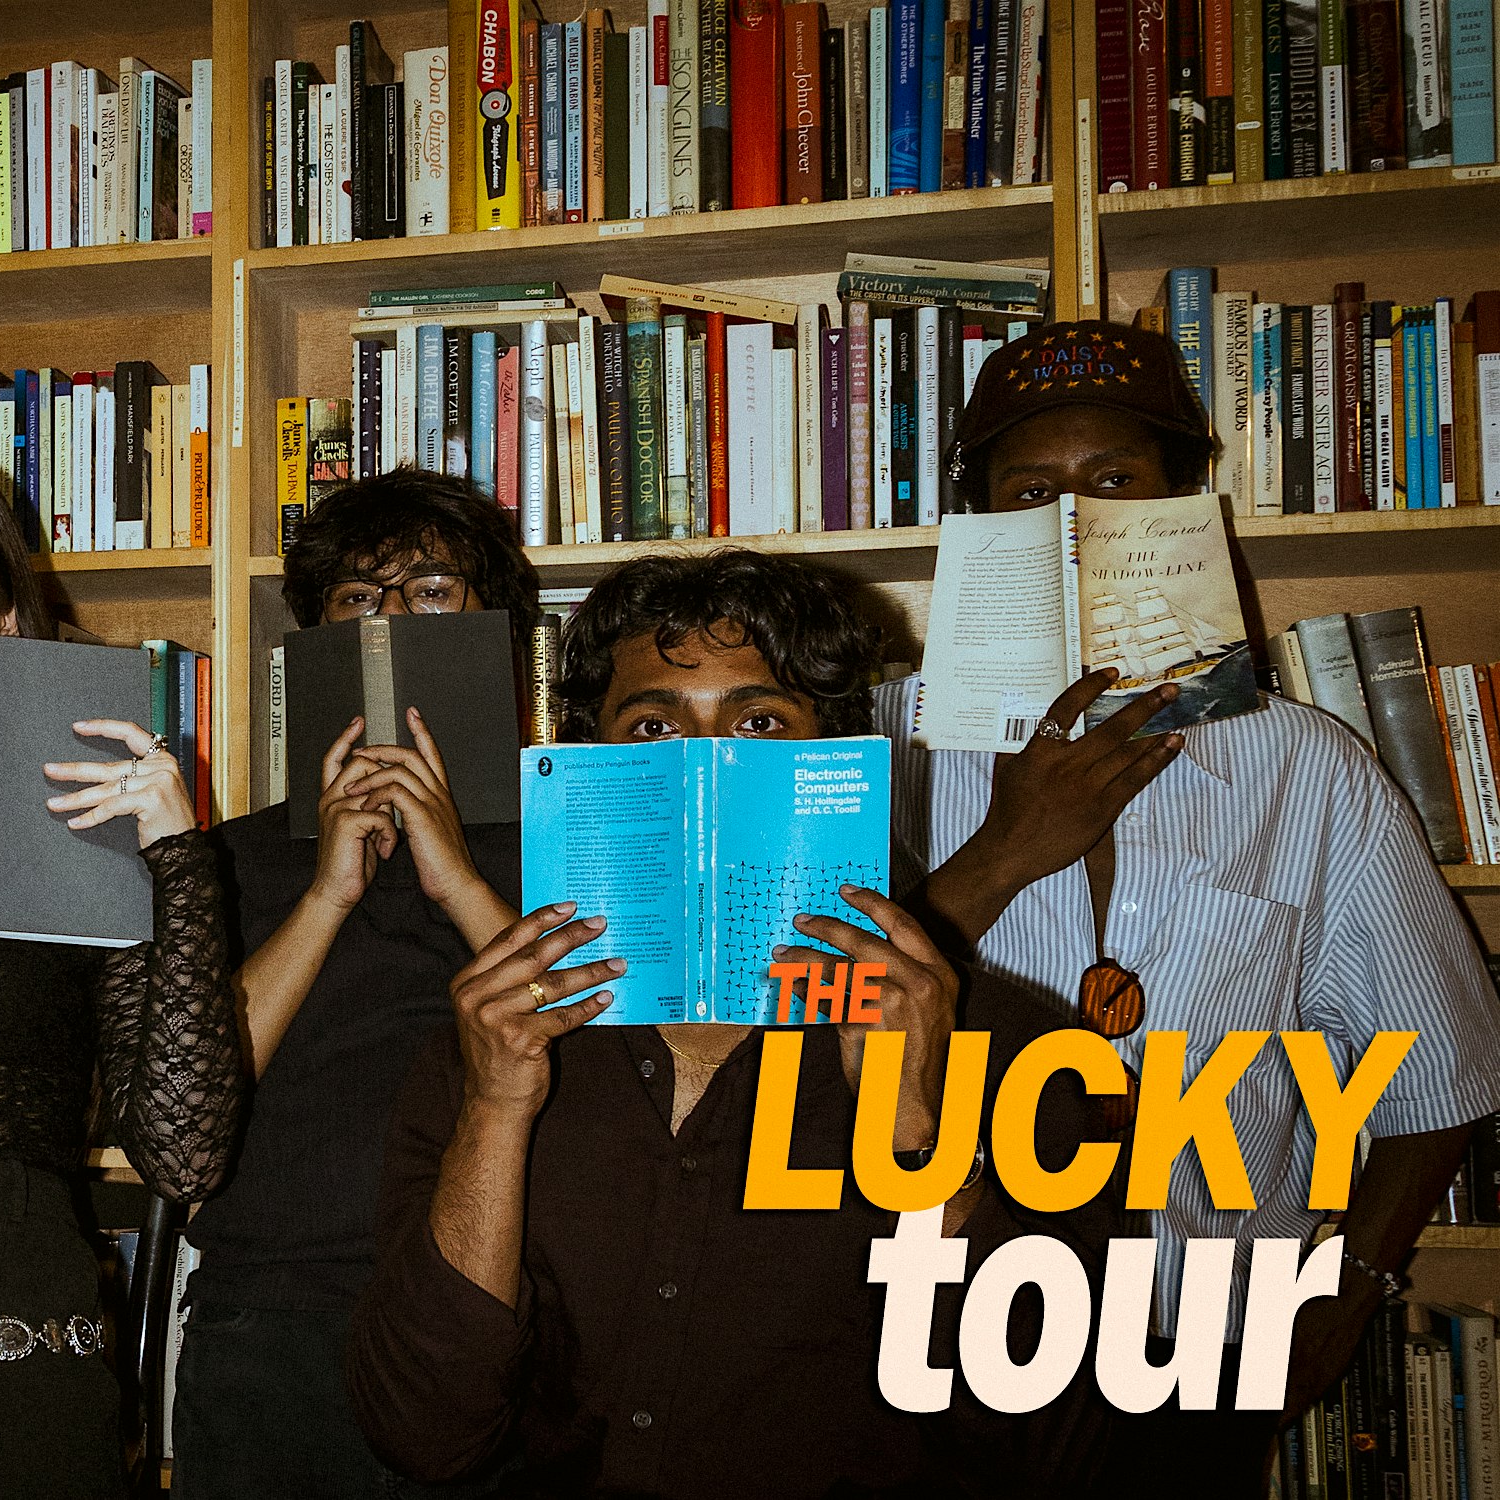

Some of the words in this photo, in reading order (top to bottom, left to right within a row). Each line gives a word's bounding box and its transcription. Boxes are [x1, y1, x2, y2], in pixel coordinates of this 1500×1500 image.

[702, 15, 711, 37] THE
[1456, 10, 1484, 19] EVERY
[481, 9, 498, 84] CHABON
[973, 43, 986, 64] The
[1421, 23, 1433, 67] CIRCUS
[1456, 46, 1486, 55] ALONE
[1460, 35, 1481, 43] DIES
[702, 39, 711, 75] BLACK
[280, 68, 288, 105] ANGELA
[429, 55, 447, 104] Don
[714, 38, 726, 107] CHATWIN
[971, 65, 985, 95] Prime
[1289, 35, 1317, 133] MIDDLESEX
[1459, 80, 1484, 88] HANS
[702, 77, 711, 107] HILL
[792, 71, 812, 109] John
[1146, 66, 1157, 110] LOUISE
[1453, 92, 1492, 100] FALLADA
[414, 99, 423, 127] Miguel
[672, 60, 692, 177] SONGLINES
[970, 96, 984, 140] Minister
[1179, 90, 1194, 131] LOUISE
[415, 129, 422, 137] de
[424, 110, 445, 179] Quixote
[797, 110, 814, 174] Cheever
[1147, 114, 1158, 170] ERDRICH
[414, 138, 422, 181] Cervantes
[1179, 134, 1195, 181] ERDRICH
[1468, 169, 1491, 177] LIT
[525, 288, 546, 296] CORGI
[849, 276, 906, 293] Victory
[913, 286, 948, 297] Joseph
[953, 288, 991, 299] Conrad
[1235, 299, 1247, 349] FAMOUS
[524, 340, 545, 387] Aleph
[1040, 346, 1107, 365] DAISY
[1235, 351, 1248, 383] LAST
[1315, 349, 1329, 397] FISHER
[634, 357, 652, 427] SPANISH
[1235, 386, 1247, 432] WORDS
[1380, 415, 1389, 429] THE
[1315, 404, 1331, 450] SISTER
[1381, 431, 1389, 458] GREAT
[636, 429, 655, 505] DOCTOR
[1316, 454, 1331, 486] AGE
[1382, 459, 1390, 488] GATSBY
[1079, 518, 1128, 546] Joseph
[1137, 517, 1212, 540] Conrad
[1091, 560, 1208, 581] SHADOW-LINE
[1126, 551, 1159, 563] THE
[1369, 668, 1426, 682] Hornblower
[1377, 658, 1415, 672] Admiral
[271, 663, 282, 708] LORD
[271, 713, 282, 739] JIM
[606, 760, 630, 768] Penguin
[794, 753, 800, 761] a
[801, 752, 830, 761] Pelican
[832, 751, 863, 761] Original
[794, 767, 863, 781] Electronic
[794, 780, 869, 795] Computers
[794, 797, 801, 805] S.
[804, 797, 813, 805] H.
[816, 797, 861, 806] Hollingdale
[794, 806, 810, 814] and
[813, 806, 821, 814] G.
[823, 806, 832, 814] C.
[834, 805, 860, 813] Tootill
